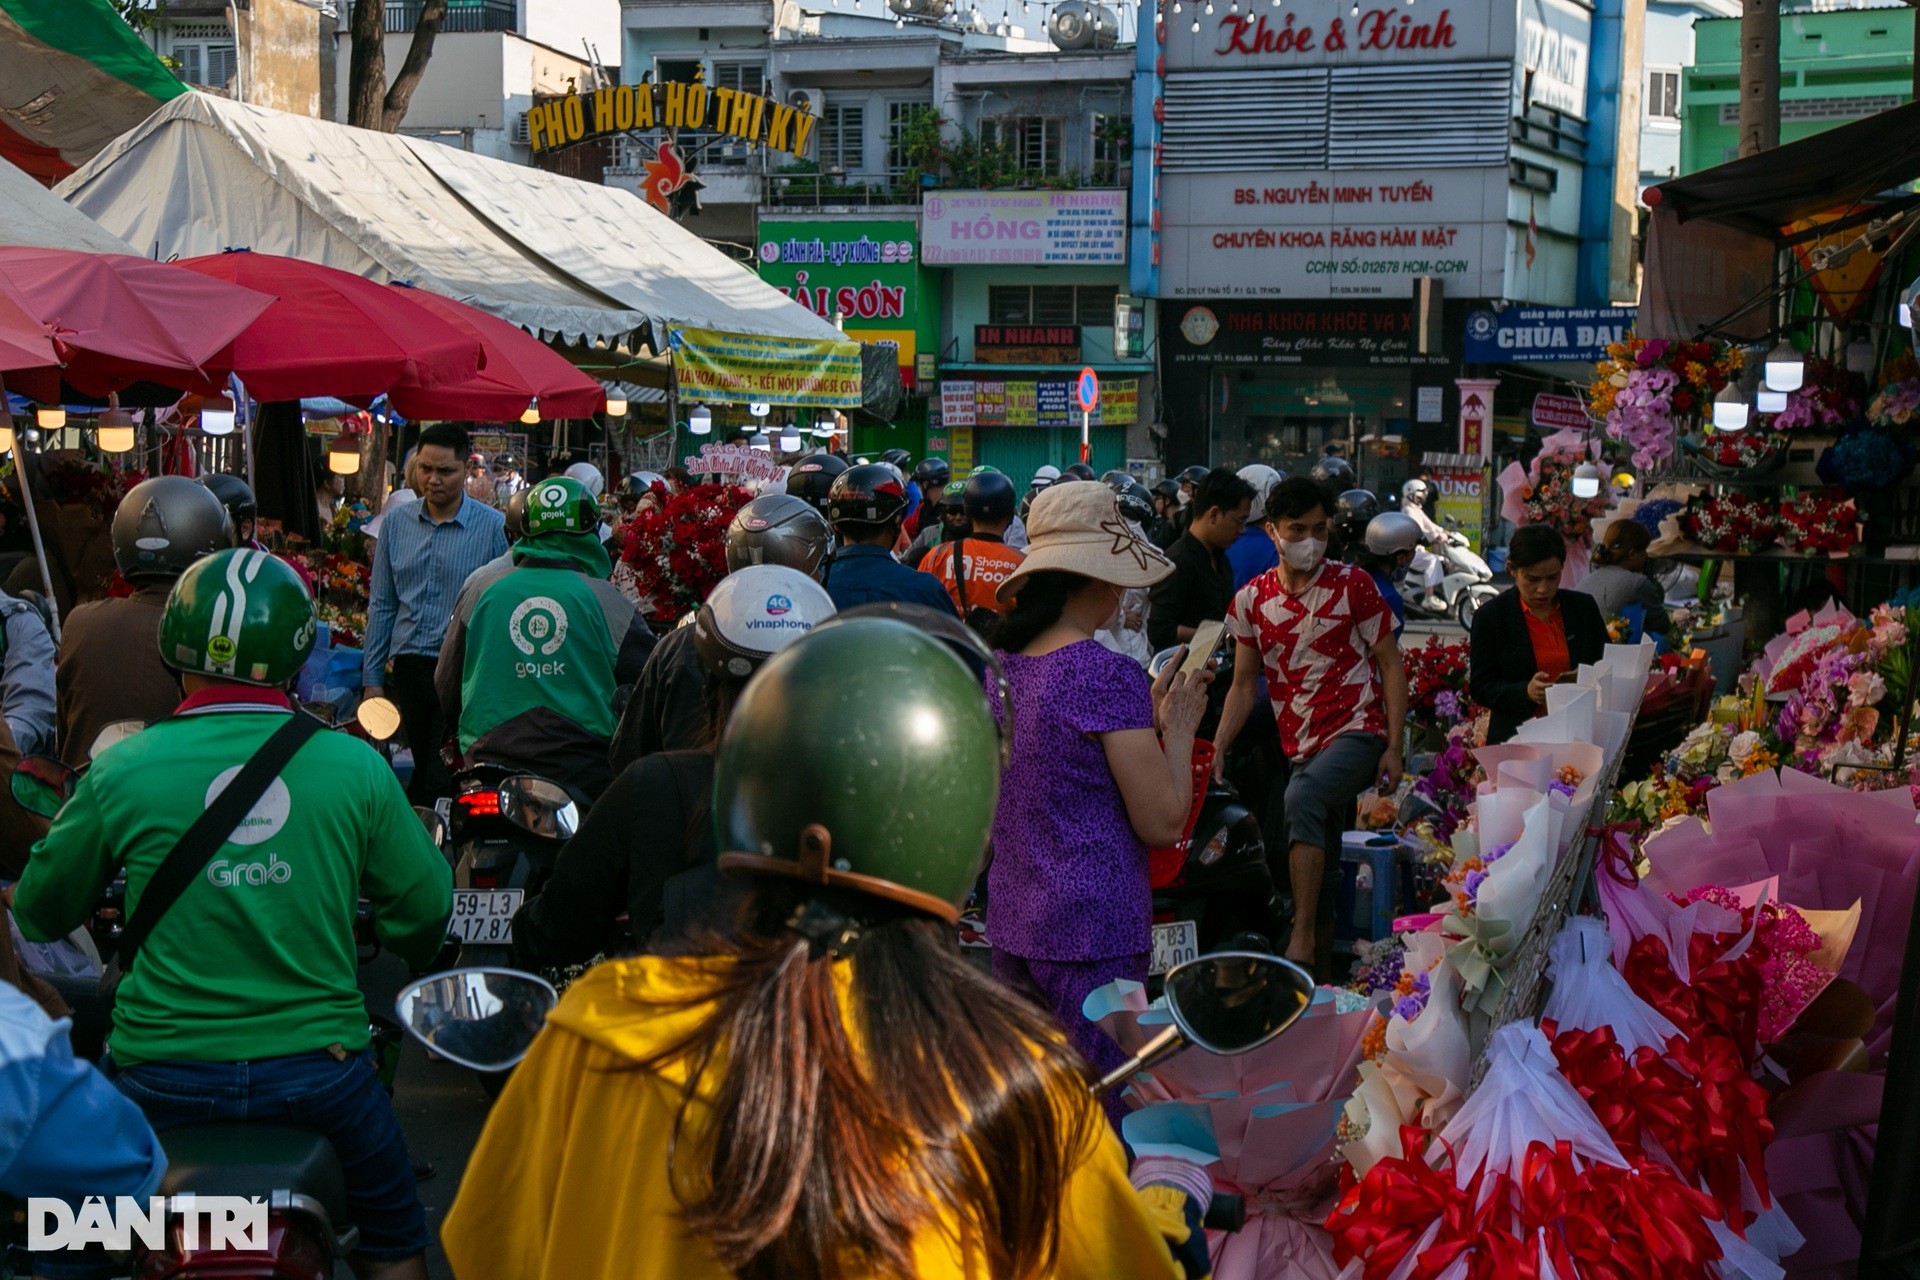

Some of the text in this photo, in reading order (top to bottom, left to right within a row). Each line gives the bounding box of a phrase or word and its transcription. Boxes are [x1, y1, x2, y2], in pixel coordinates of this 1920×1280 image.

[1214, 7, 1458, 56] Khỏe & Xinh
[594, 82, 654, 134] HOA
[665, 63, 707, 129] HỒ
[715, 86, 765, 150] THỊ
[1234, 180, 1433, 205] BS. NGUYỄN MINH TUYẾN
[950, 212, 1041, 241] HỒNG
[1212, 225, 1457, 250] CHUYÊN KHOA RĂNG HÀM MẶT
[782, 237, 807, 263] BÁNH
[808, 237, 824, 263] PÍA
[830, 241, 848, 266] LẠP
[1306, 260, 1337, 274] CCHN
[836, 279, 906, 319] SƠN
[979, 327, 1074, 345] IN NHANH
[1497, 321, 1568, 348] CHÙA
[1576, 325, 1623, 352] ĐẠI
[759, 373, 776, 390] KẾT
[777, 373, 795, 391] NỐI
[739, 445, 775, 461] CON
[540, 510, 566, 520] gojek
[975, 556, 1017, 570] Shopee
[769, 597, 788, 607] 4G
[745, 619, 812, 630] vinaphone
[515, 660, 566, 679] gojek
[207, 852, 292, 888] Grab
[456, 893, 512, 916] 59-L3
